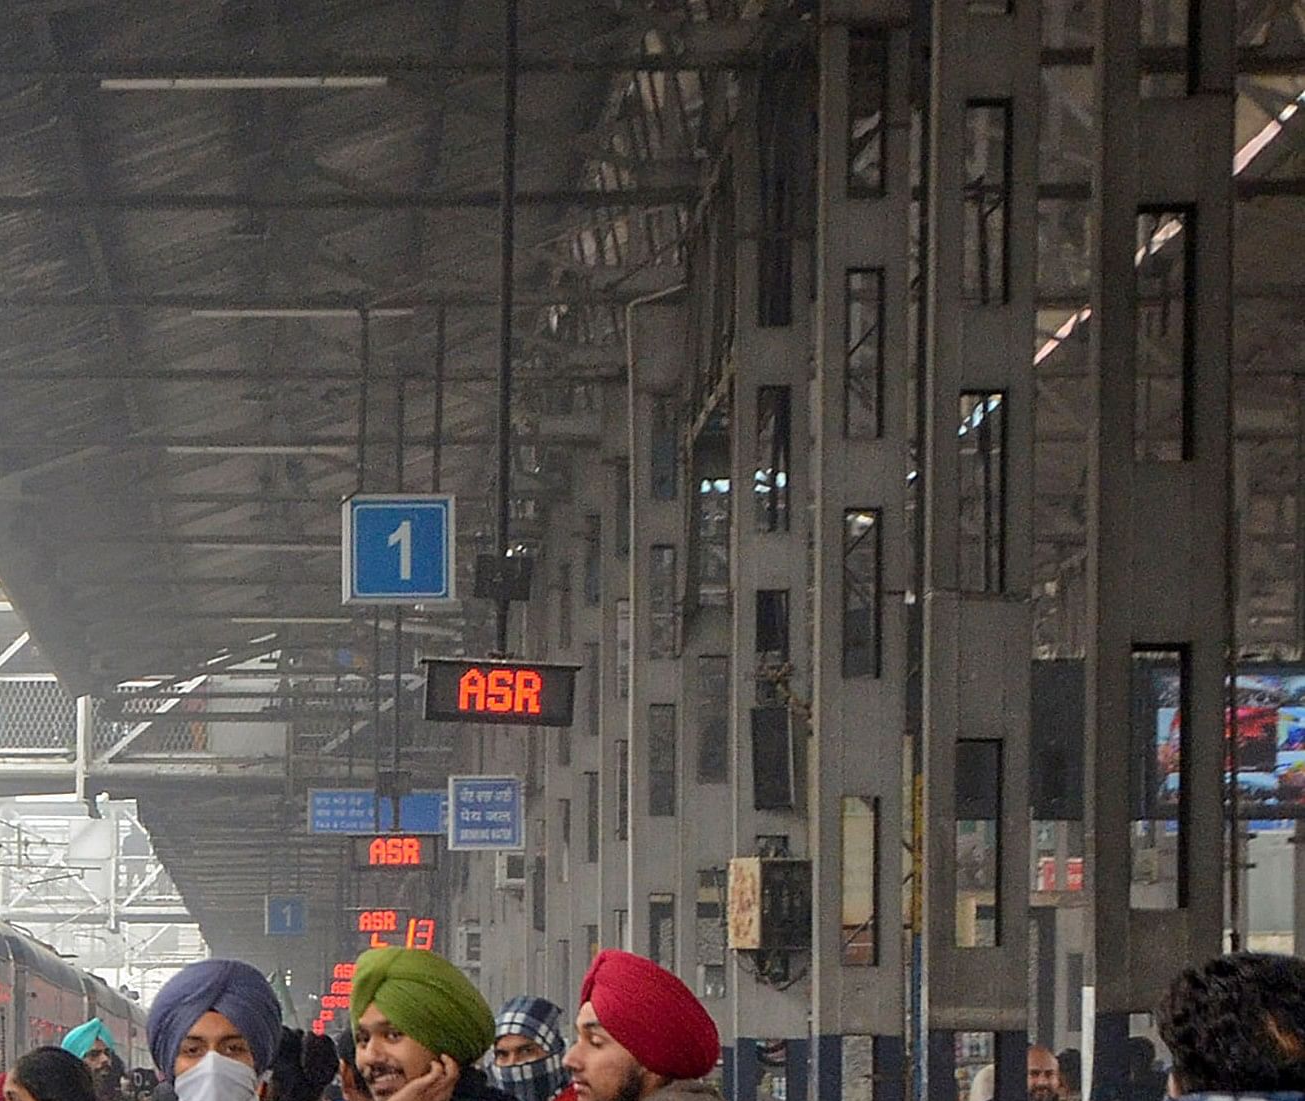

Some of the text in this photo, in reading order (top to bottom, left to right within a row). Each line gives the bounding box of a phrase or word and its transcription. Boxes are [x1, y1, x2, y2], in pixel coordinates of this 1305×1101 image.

[387, 520, 411, 581] 1
[459, 667, 542, 714] ASR
[369, 837, 422, 865] ASR
[281, 905, 292, 928] 1
[358, 911, 398, 931] ASR
